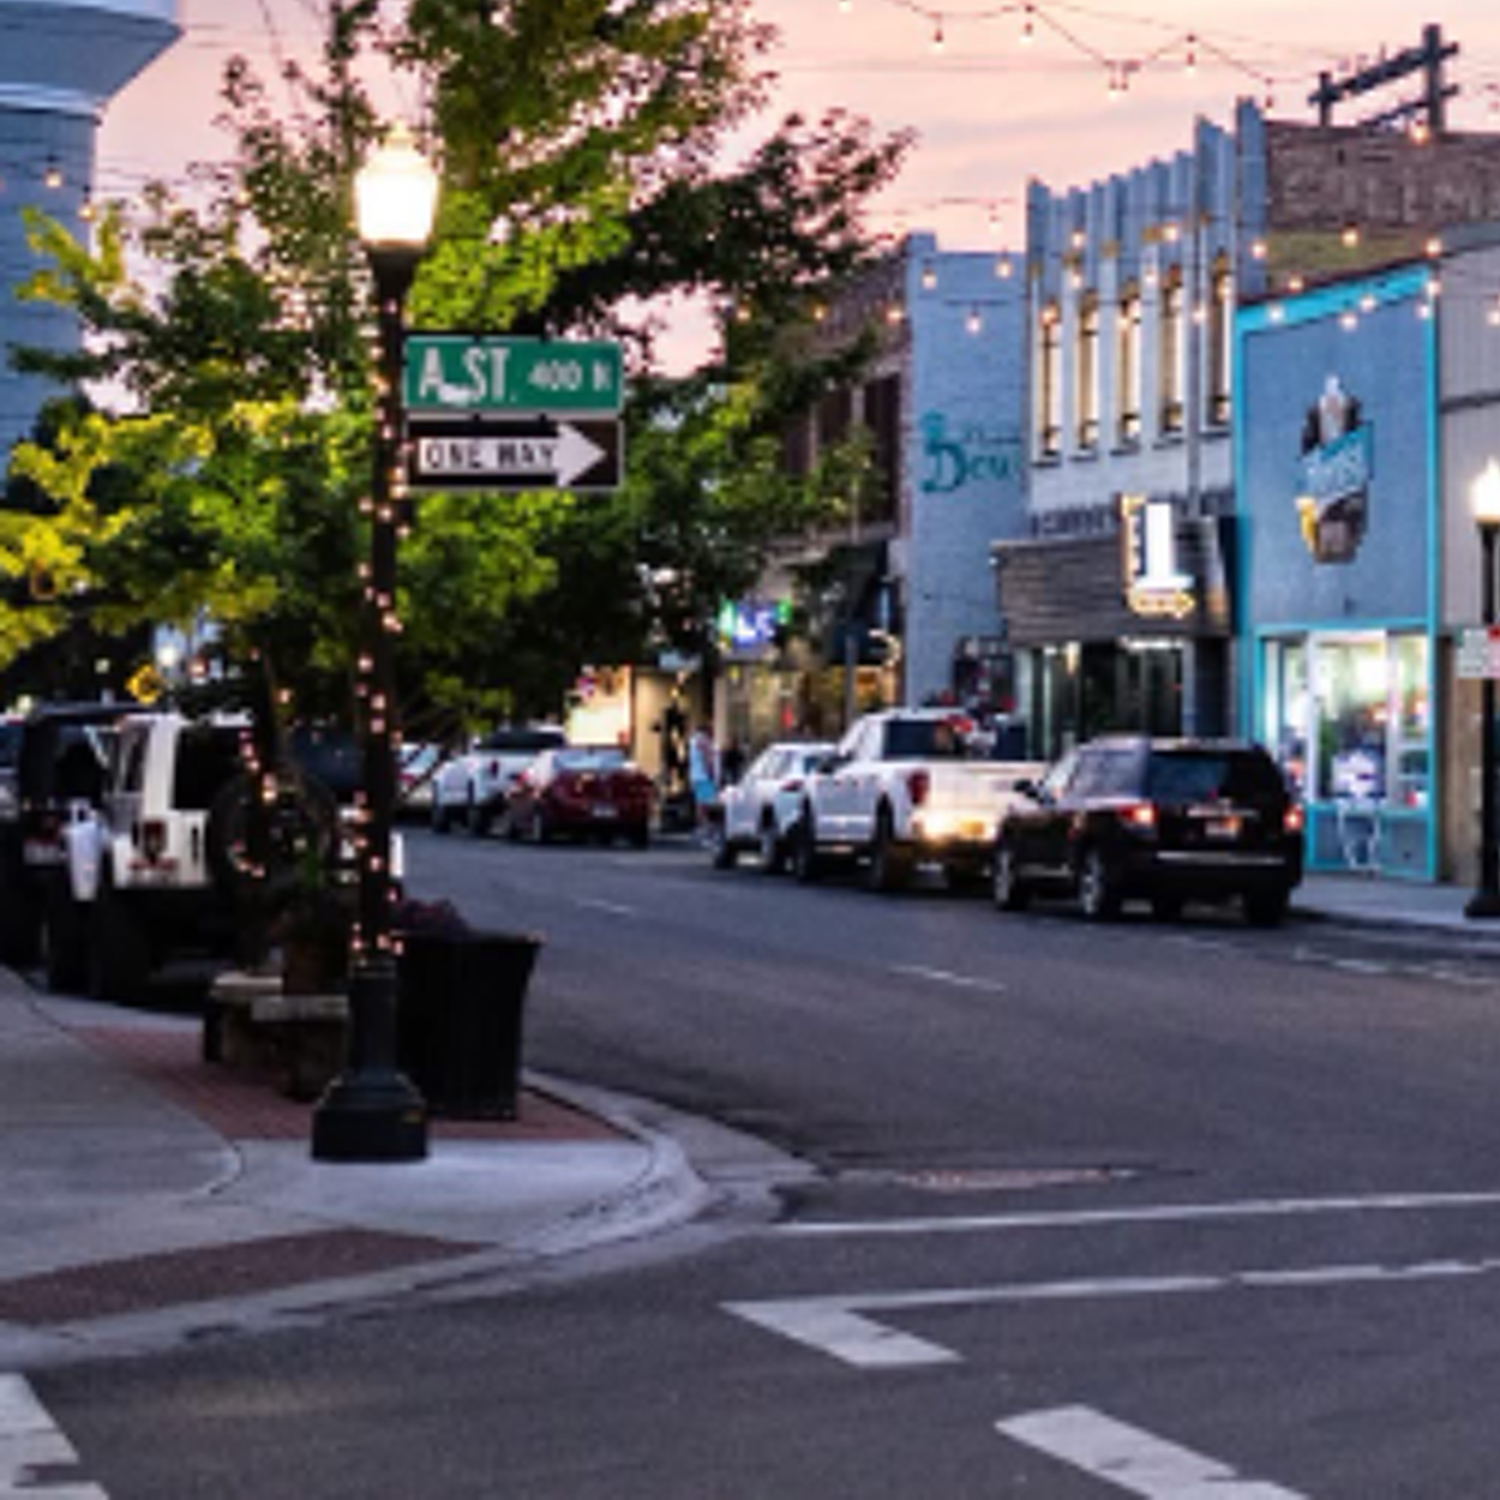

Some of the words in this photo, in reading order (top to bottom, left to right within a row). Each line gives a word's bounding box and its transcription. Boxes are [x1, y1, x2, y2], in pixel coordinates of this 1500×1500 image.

[417, 347, 444, 398] A
[528, 359, 583, 392] 400
[425, 442, 482, 468] ONE
[497, 442, 553, 469] WAY
